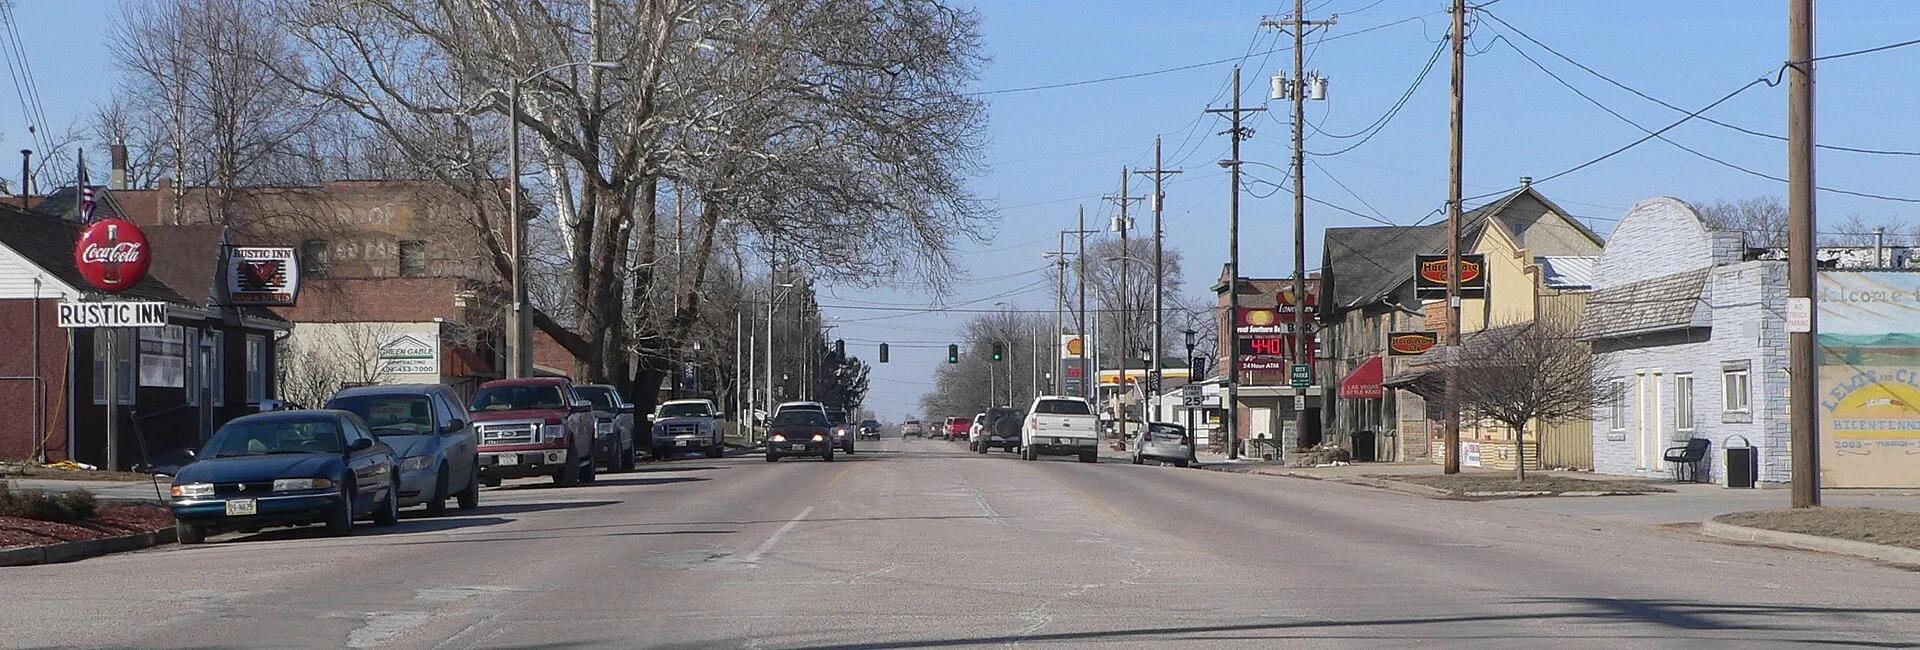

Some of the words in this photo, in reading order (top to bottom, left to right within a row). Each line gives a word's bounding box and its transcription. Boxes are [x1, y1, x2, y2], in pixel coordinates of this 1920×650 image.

[82, 241, 143, 263] Coca-Cola
[233, 249, 271, 259] RUSTIC
[272, 249, 291, 259] INN
[60, 303, 130, 325] RUSTIC
[136, 303, 165, 324] INN
[1249, 325, 1273, 333] Southern
[1287, 323, 1312, 332] BR
[1822, 369, 1876, 412] LEWIS
[1185, 397, 1201, 406] 25
[1834, 441, 1862, 449] 2003
